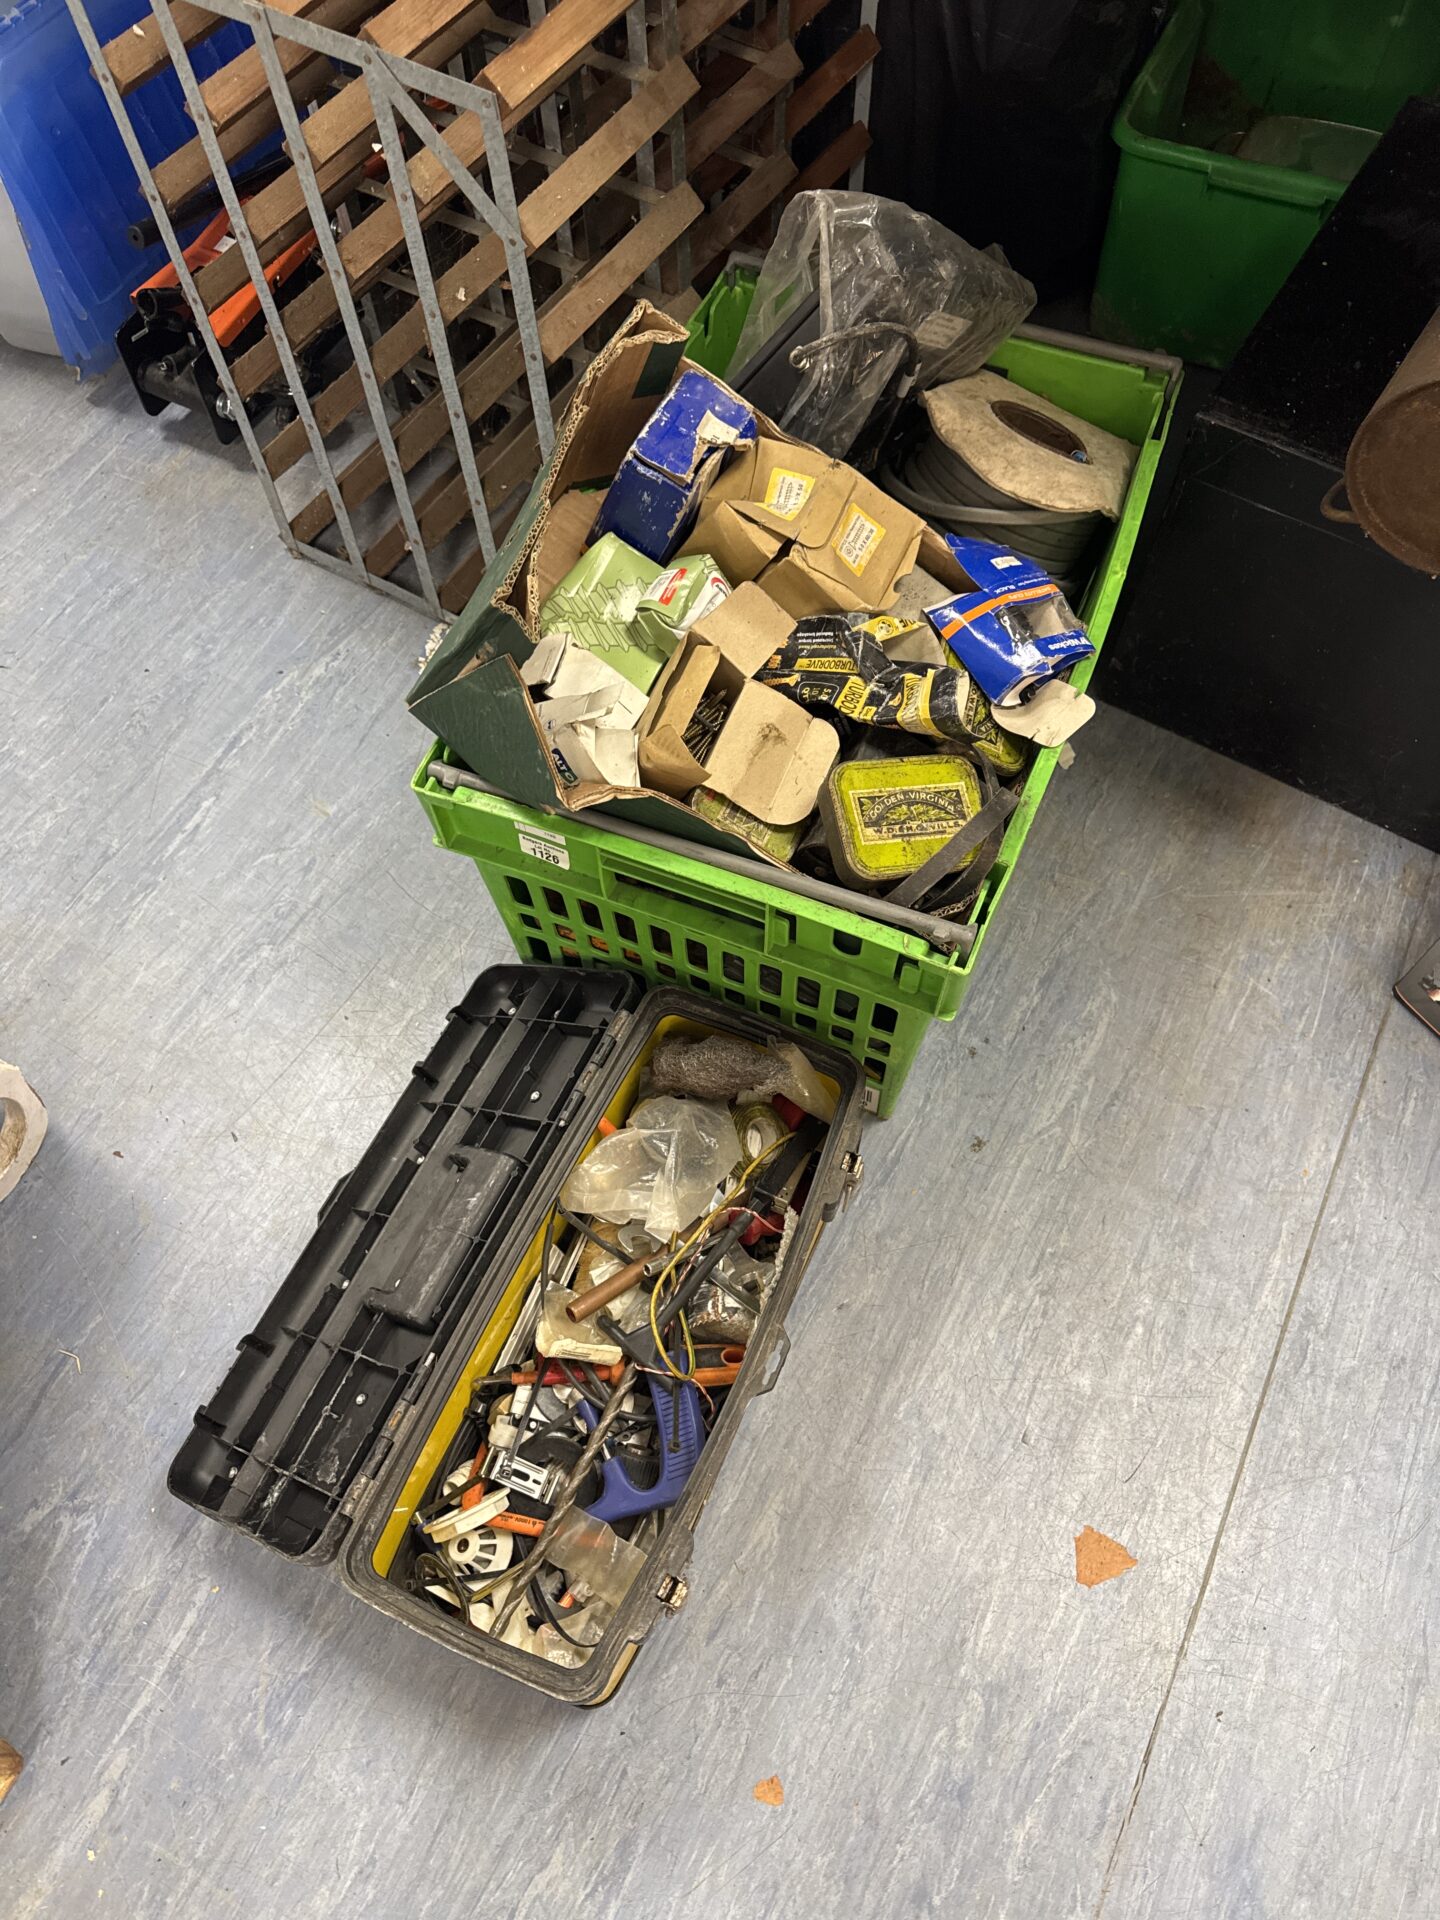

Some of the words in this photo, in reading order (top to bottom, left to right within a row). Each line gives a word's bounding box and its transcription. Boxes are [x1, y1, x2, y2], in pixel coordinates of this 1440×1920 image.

[1048, 638, 1081, 650] Wickes
[838, 681, 867, 715] TURBOD
[551, 754, 575, 783] ALTO
[531, 847, 560, 865] 1126
